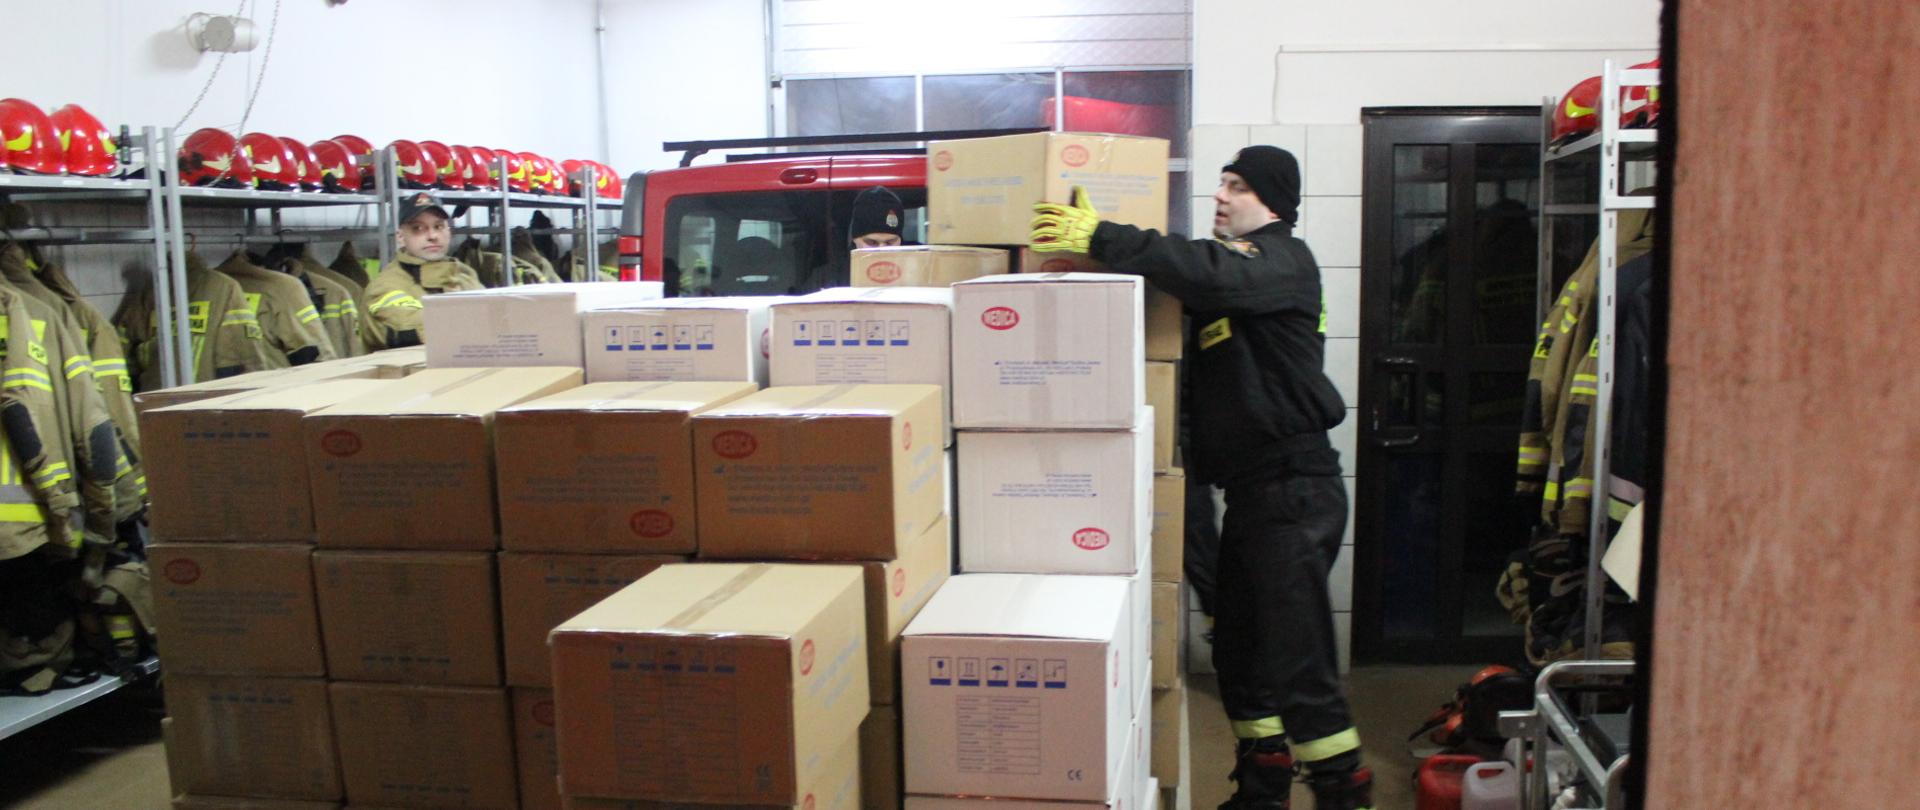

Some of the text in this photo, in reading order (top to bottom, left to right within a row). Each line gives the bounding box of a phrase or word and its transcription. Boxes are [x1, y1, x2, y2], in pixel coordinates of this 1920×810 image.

[983, 309, 1018, 327] MEDICA
[714, 432, 756, 457] MEDICA
[1073, 530, 1108, 548] MEDICA
